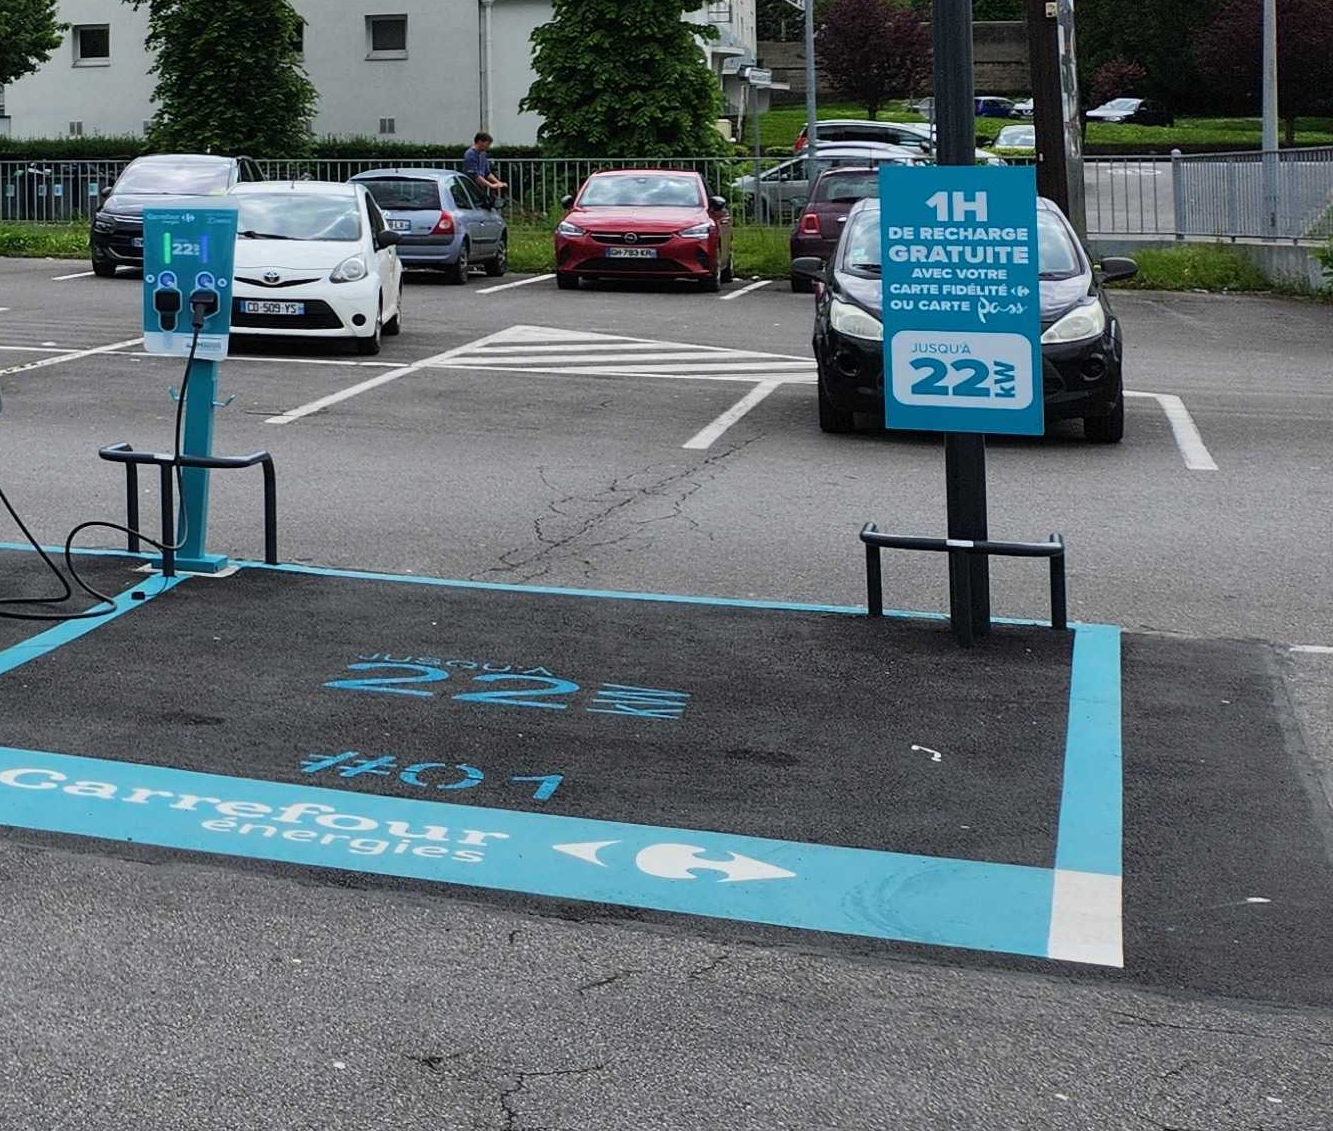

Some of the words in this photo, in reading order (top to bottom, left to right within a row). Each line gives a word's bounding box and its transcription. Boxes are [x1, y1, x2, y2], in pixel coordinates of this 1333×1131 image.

[925, 191, 988, 222] 1H
[888, 227, 915, 240] DE
[919, 228, 1029, 241] RECHARGE
[172, 243, 194, 255] 22
[888, 245, 1029, 264] GRATUITE
[911, 268, 953, 279] AVEC
[955, 269, 1008, 280] VOTRE
[890, 284, 939, 294] CARTE
[942, 283, 1008, 296] FIDÉLITÉ
[890, 300, 914, 310] OU
[918, 301, 971, 311] CARTE
[909, 357, 991, 398] 22
[322, 662, 581, 710] 22
[200, 817, 487, 864] énergies
